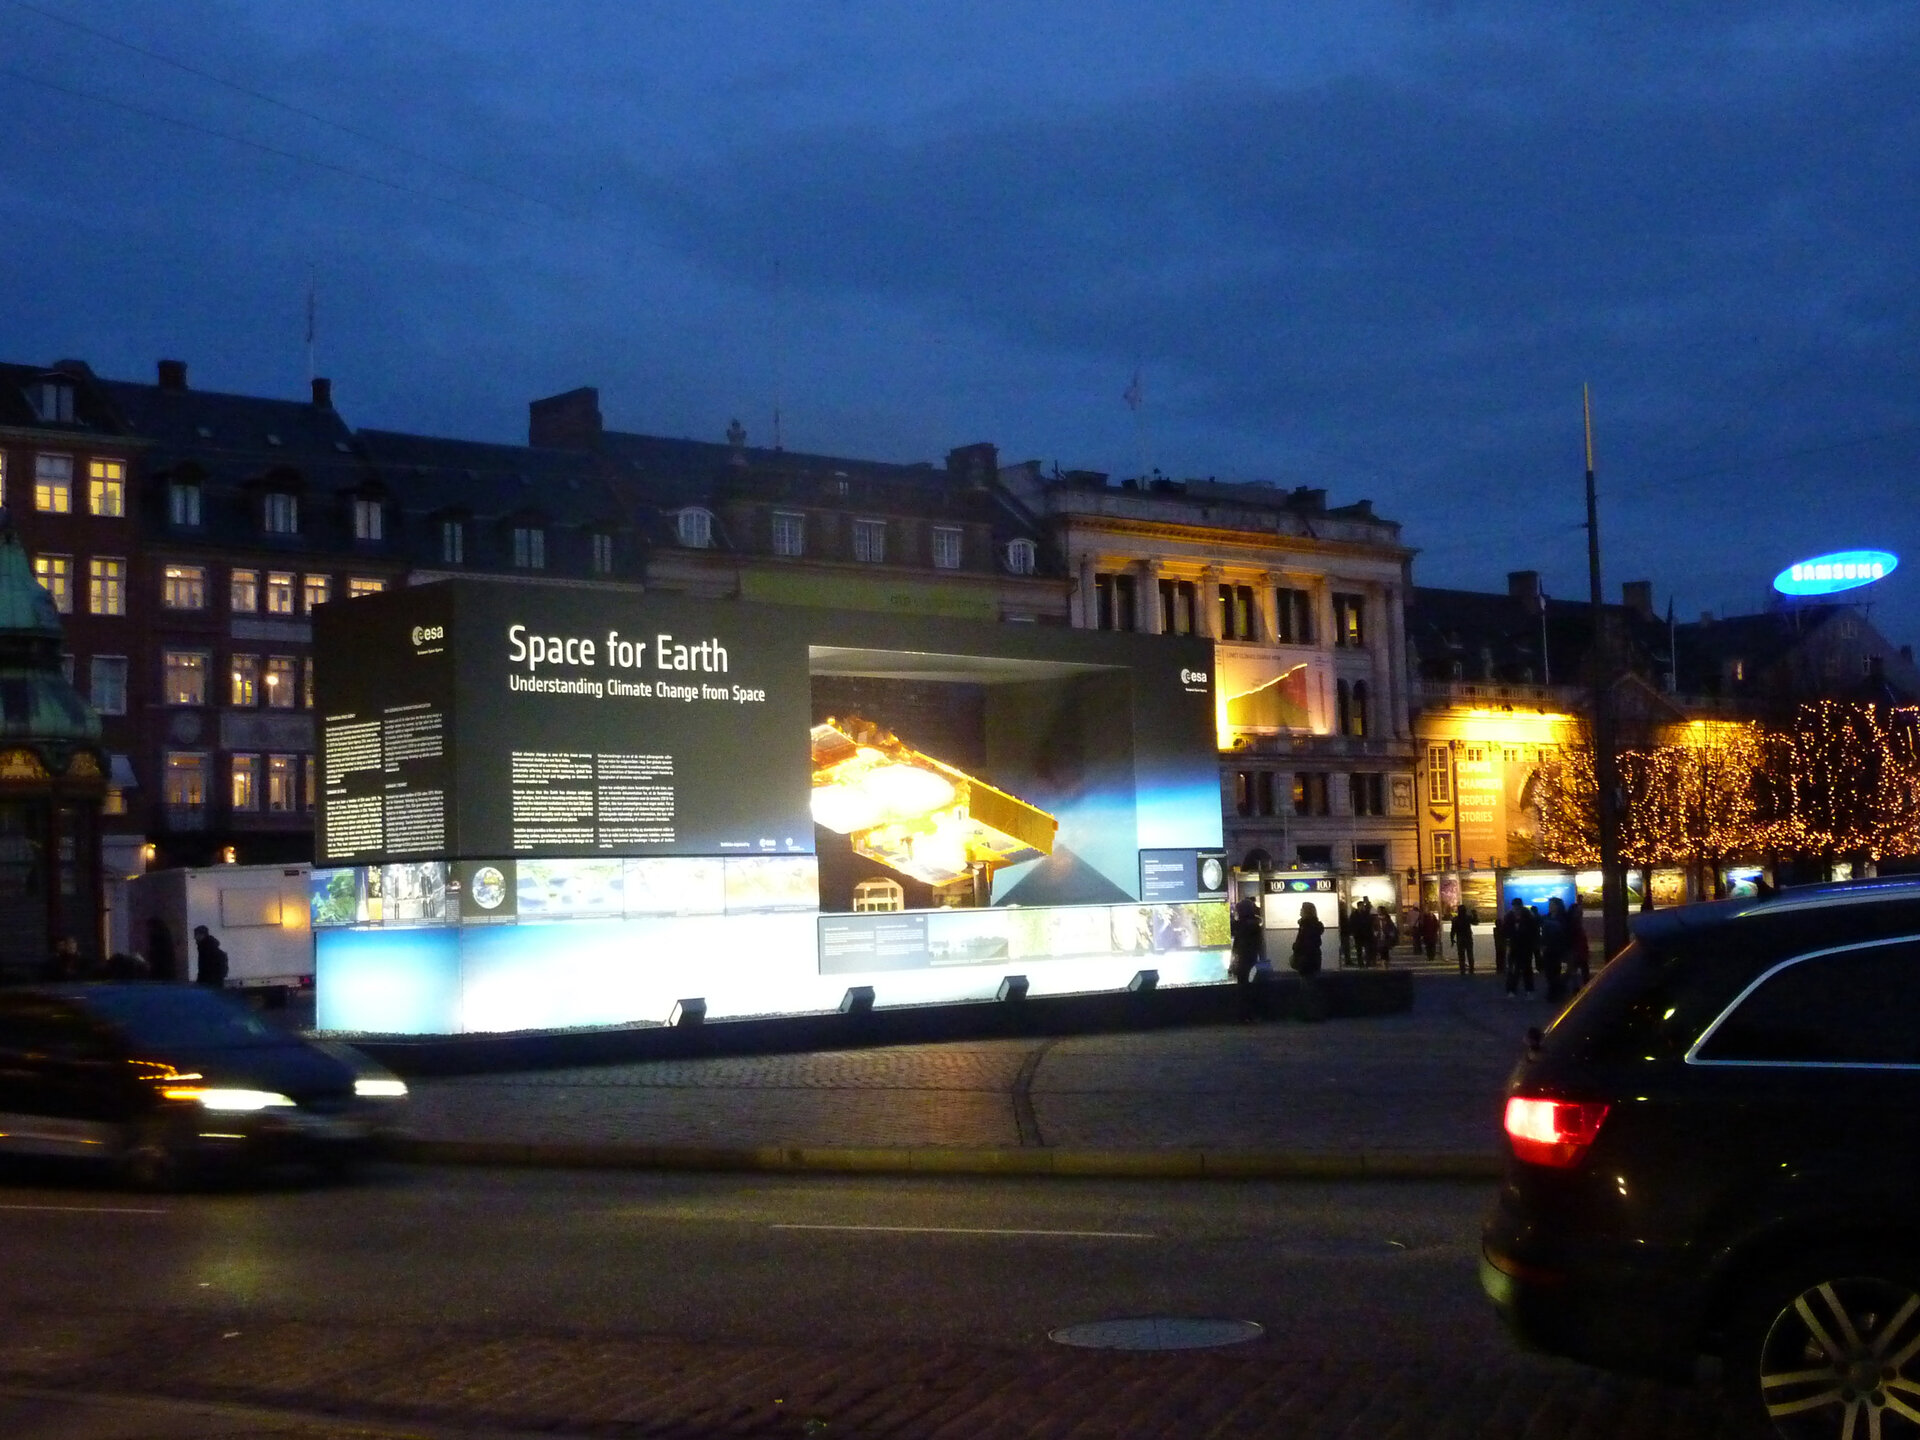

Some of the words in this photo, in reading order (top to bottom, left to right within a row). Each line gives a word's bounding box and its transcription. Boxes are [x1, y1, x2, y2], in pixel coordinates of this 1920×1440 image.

[1791, 563, 1883, 582] SAMSUNG
[424, 626, 444, 641] esa
[509, 625, 595, 671] Space
[607, 631, 646, 668] for
[657, 634, 728, 672] Earth
[1191, 672, 1208, 683] esa
[510, 674, 603, 698] Understanding
[607, 679, 653, 697] Climate
[656, 681, 699, 702] Change
[702, 683, 729, 700] from
[732, 684, 766, 704] Space
[1459, 794, 1497, 806] PEOPLE'S
[1459, 811, 1494, 823] STORIES
[1271, 881, 1285, 890] 100
[1316, 880, 1331, 889] 100
